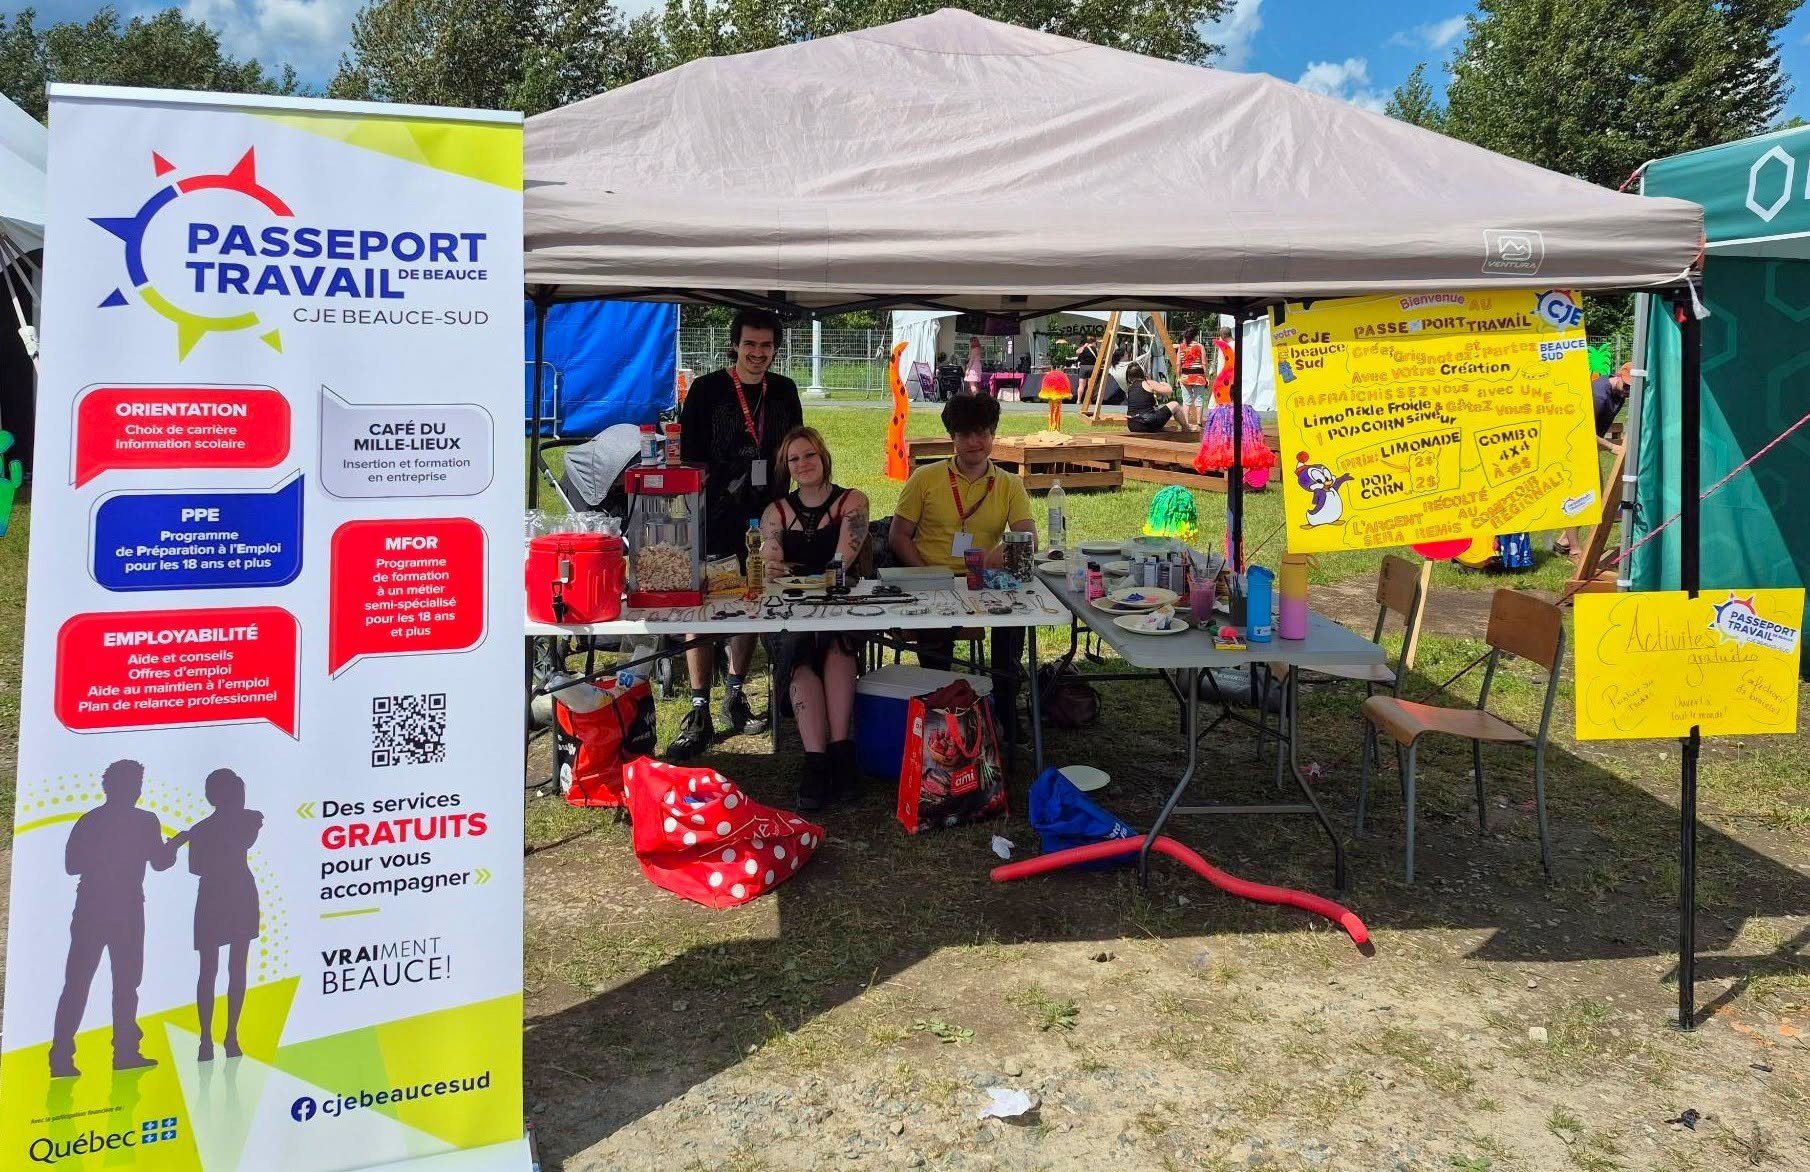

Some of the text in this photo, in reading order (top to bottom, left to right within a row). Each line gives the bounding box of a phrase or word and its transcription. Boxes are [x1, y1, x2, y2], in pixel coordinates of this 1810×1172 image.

[188, 223, 487, 263] PASSEPORT
[1488, 260, 1536, 269] VENTURA
[186, 262, 487, 299] TRAVAIL DE BEAUCE
[1400, 293, 1492, 311] Bienvenue AU
[294, 308, 488, 325] CJE BEAUCE-SUD
[1548, 299, 1584, 326] CJE
[1298, 332, 1330, 344] CJE
[1291, 344, 1345, 358] beauce
[1540, 340, 1585, 352] BEAUCE
[1295, 357, 1323, 370] Sud
[1541, 352, 1563, 361] SUD
[1441, 362, 1510, 375] Création
[116, 402, 247, 417] ORIENTATION
[1303, 404, 1384, 428] Limonade
[1388, 399, 1431, 414] Froide
[125, 425, 237, 435] Choix de carrière
[369, 419, 446, 436] CAFÉ DU
[116, 439, 245, 449] Information scolaire
[354, 437, 461, 451] MILLE-LIEUX
[1380, 432, 1461, 458] LIMONADE
[1479, 428, 1538, 447] COMBO
[343, 458, 470, 470] Insertion et formation
[1415, 456, 1433, 468] 2$
[368, 471, 446, 484] en entreprise
[1361, 474, 1392, 488] POP
[1416, 475, 1436, 489] 2$
[1361, 481, 1404, 499] CORN
[181, 508, 219, 522] PPE
[160, 530, 239, 543] Programme
[385, 536, 438, 551] MFOR
[116, 543, 281, 557] de Préparation à l'Emploi
[125, 557, 271, 573] pour les 18 ans et plus
[376, 557, 446, 570] Programme
[373, 570, 449, 582] de formation
[377, 583, 445, 596] à un métier
[365, 597, 456, 611] semi-spécialisé
[365, 612, 455, 626] pour les 18 ans
[1731, 611, 1796, 637] PASSEPORT
[104, 624, 258, 647] EMPLOYABILITÉ
[391, 625, 431, 638] et plus
[1728, 621, 1773, 641] TRAVAIL
[128, 650, 234, 664] Aide et conseils
[128, 664, 232, 679] Offres d'emploi
[88, 677, 269, 696] Aide au maintien à l'emploi
[78, 691, 277, 712] Plan de relance professionnel
[956, 769, 973, 786] ami
[323, 800, 364, 819] Des
[373, 793, 460, 812] services
[321, 812, 488, 850] GRATUITS
[321, 850, 431, 880] pour vous
[320, 869, 470, 901] accompagner
[322, 937, 441, 968] VRAIMENT
[323, 955, 451, 995] BEAUCE!
[323, 1071, 491, 1117] cjebeaucesud
[29, 1130, 136, 1164] Québec
